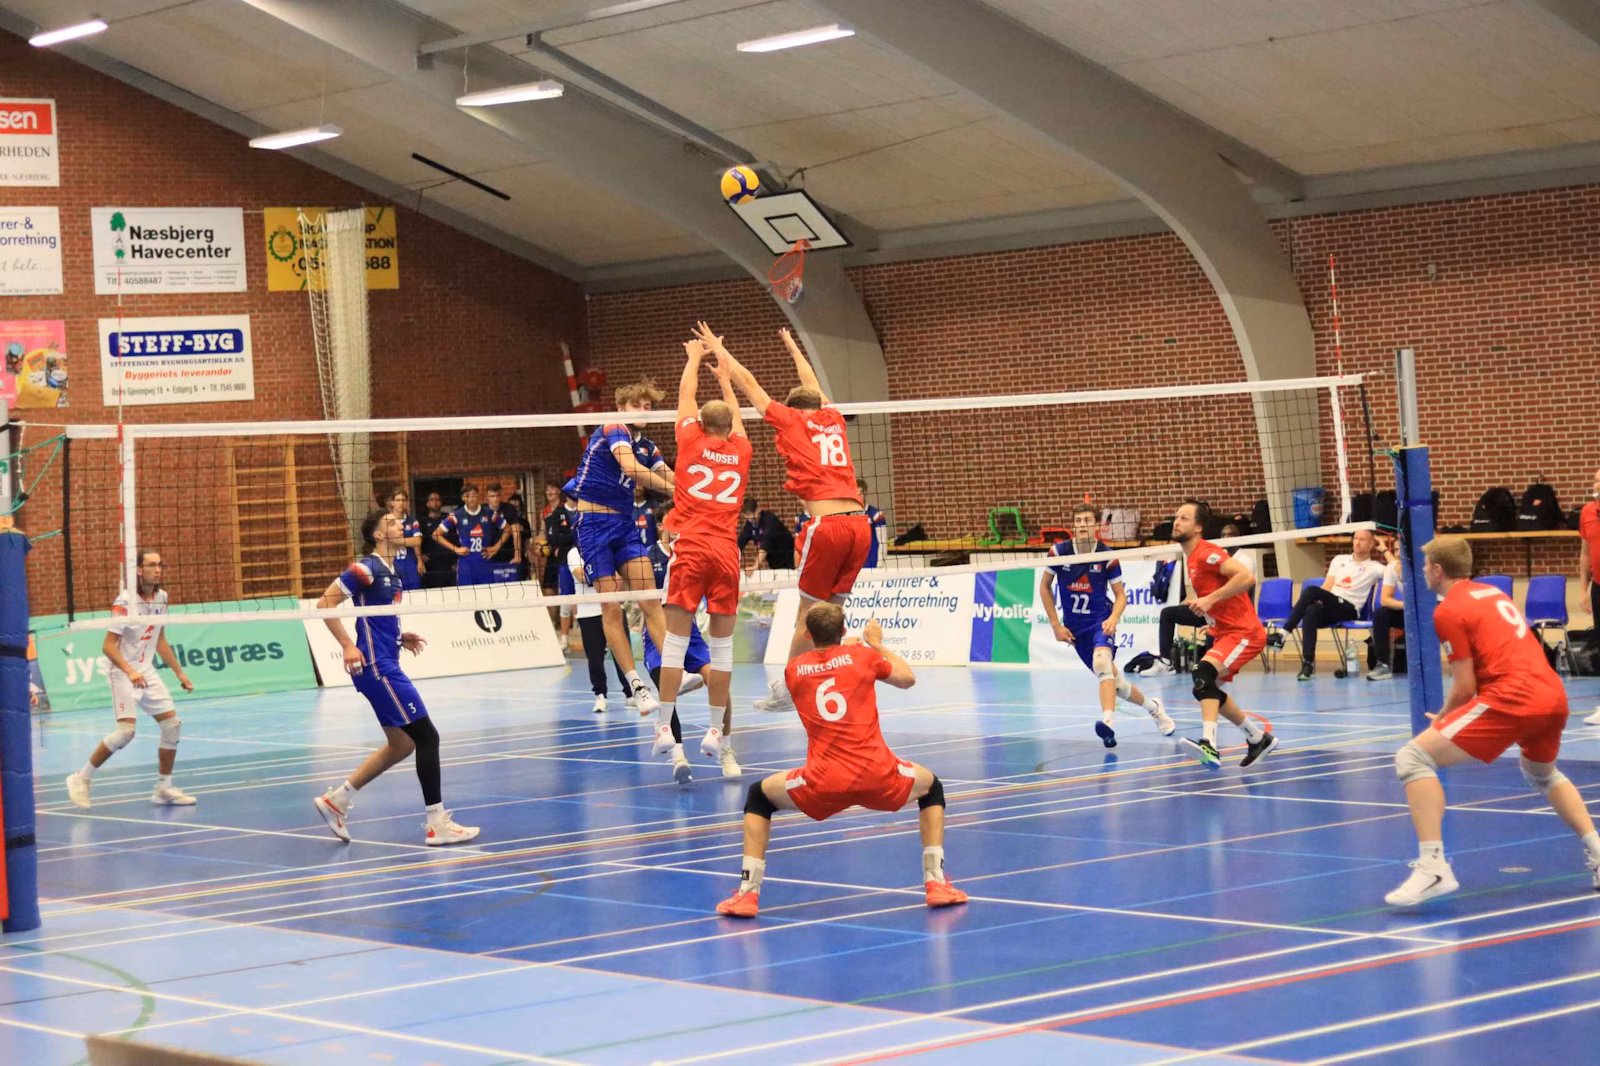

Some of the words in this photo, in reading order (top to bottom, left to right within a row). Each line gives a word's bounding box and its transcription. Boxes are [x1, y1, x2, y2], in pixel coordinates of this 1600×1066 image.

[130, 225, 214, 243] Næsbjerg
[131, 245, 231, 259] Havecenter
[119, 333, 234, 354] STEFF-BYG
[125, 370, 178, 380] Byggeriets
[702, 448, 738, 465] MADSEN
[811, 433, 848, 466] 18
[687, 464, 741, 504] 22
[470, 537, 483, 553] 28
[845, 589, 958, 613] Snedkerforretning
[1070, 593, 1091, 615] 22
[972, 603, 1033, 624] Nybolig
[1123, 613, 1149, 624] kontakt
[1497, 600, 1527, 639] 9
[451, 638, 495, 650] neptun
[498, 630, 541, 643] apotek
[1120, 633, 1134, 648] 24
[796, 653, 853, 677] MIKELSONS
[119, 702, 125, 711] 9
[408, 702, 417, 714] 3
[815, 677, 848, 722] 6
